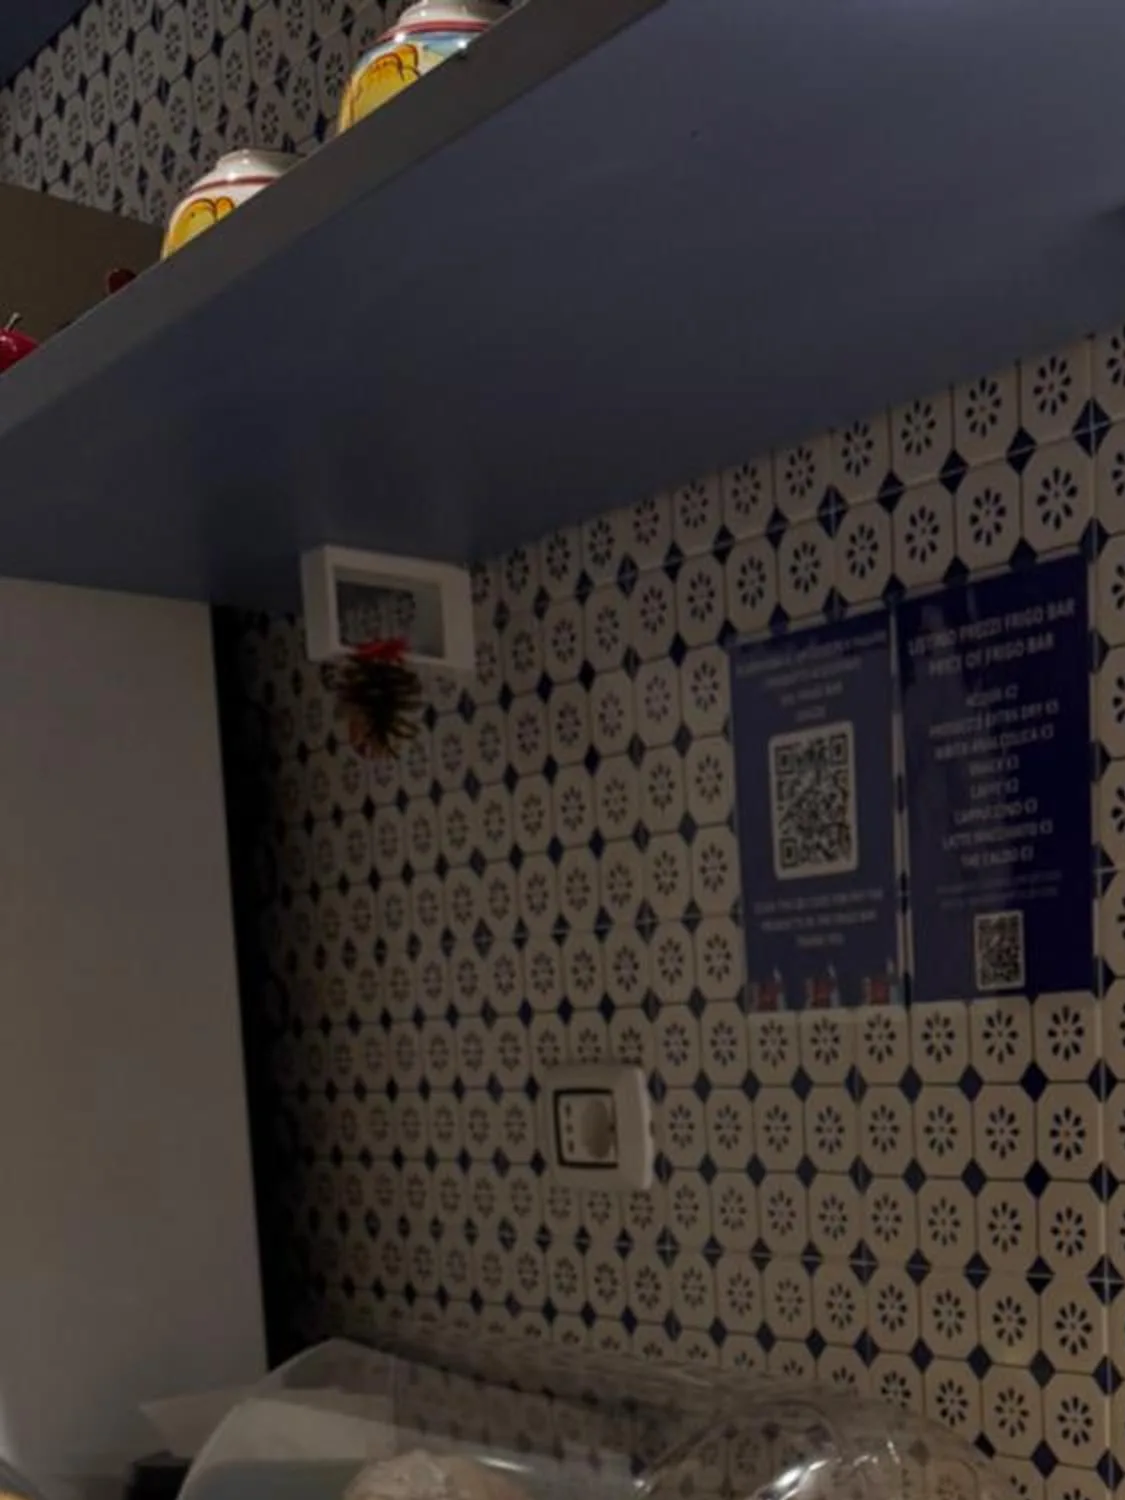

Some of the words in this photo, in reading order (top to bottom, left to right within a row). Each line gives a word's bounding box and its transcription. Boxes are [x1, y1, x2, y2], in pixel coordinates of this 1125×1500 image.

[1005, 606, 1042, 631] FRIGO
[1047, 597, 1075, 620] BAR
[985, 640, 1023, 663] FRIGO
[1027, 632, 1053, 653] BAR
